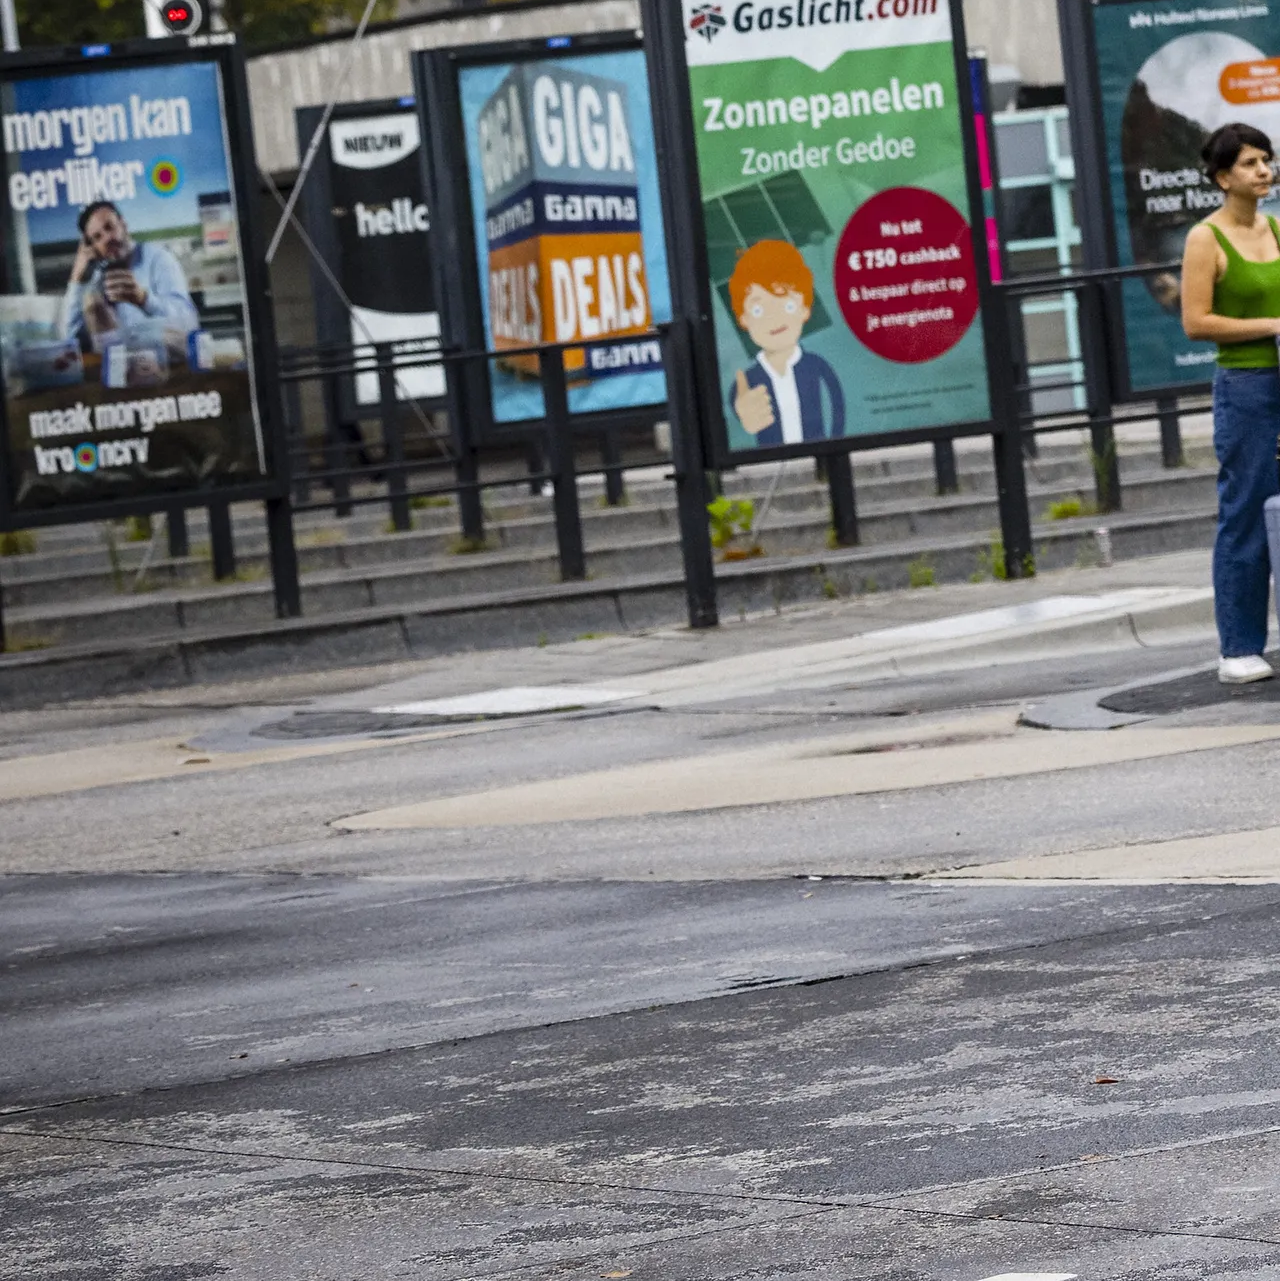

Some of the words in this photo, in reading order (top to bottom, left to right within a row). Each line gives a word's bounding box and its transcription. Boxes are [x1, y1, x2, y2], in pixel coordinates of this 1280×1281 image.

[2, 102, 128, 156] morgen
[129, 94, 192, 140] kan
[533, 75, 635, 173] GIGA
[702, 77, 945, 132] Zonnepanelen
[343, 132, 402, 153] NIEUW
[740, 141, 831, 175] Zonder
[835, 133, 916, 164] Gedoe
[9, 157, 145, 211] eerlijker
[1139, 168, 1200, 191] Directe
[880, 220, 900, 237] Nu
[900, 218, 923, 235] tot
[848, 251, 862, 271] €
[862, 247, 897, 270] 750
[900, 243, 961, 266] cashback
[550, 251, 647, 343] DEALS
[849, 287, 861, 302] &
[860, 282, 909, 301] bespaar
[910, 278, 947, 296] direct
[948, 276, 967, 293] op
[866, 313, 880, 333] je
[881, 306, 954, 328] energienota
[29, 401, 93, 438] maak
[94, 396, 179, 432] morgen
[178, 390, 222, 421] mee
